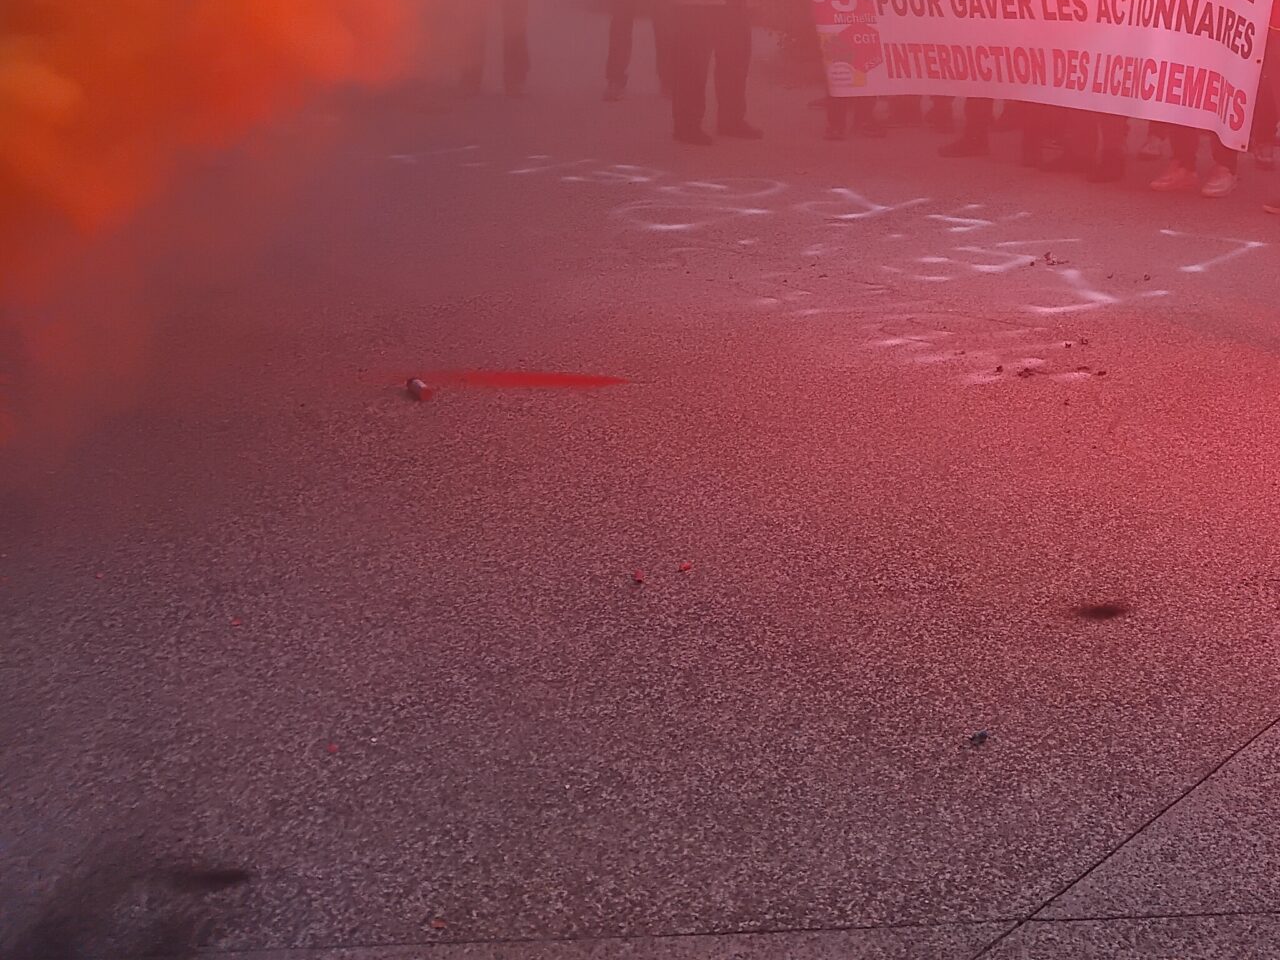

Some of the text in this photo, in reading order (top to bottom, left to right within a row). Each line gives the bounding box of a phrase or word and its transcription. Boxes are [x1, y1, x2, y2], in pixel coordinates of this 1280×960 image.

[854, 33, 877, 45] CGT
[884, 43, 1247, 131] INTERDICTION DES LICENCIEMENTS
